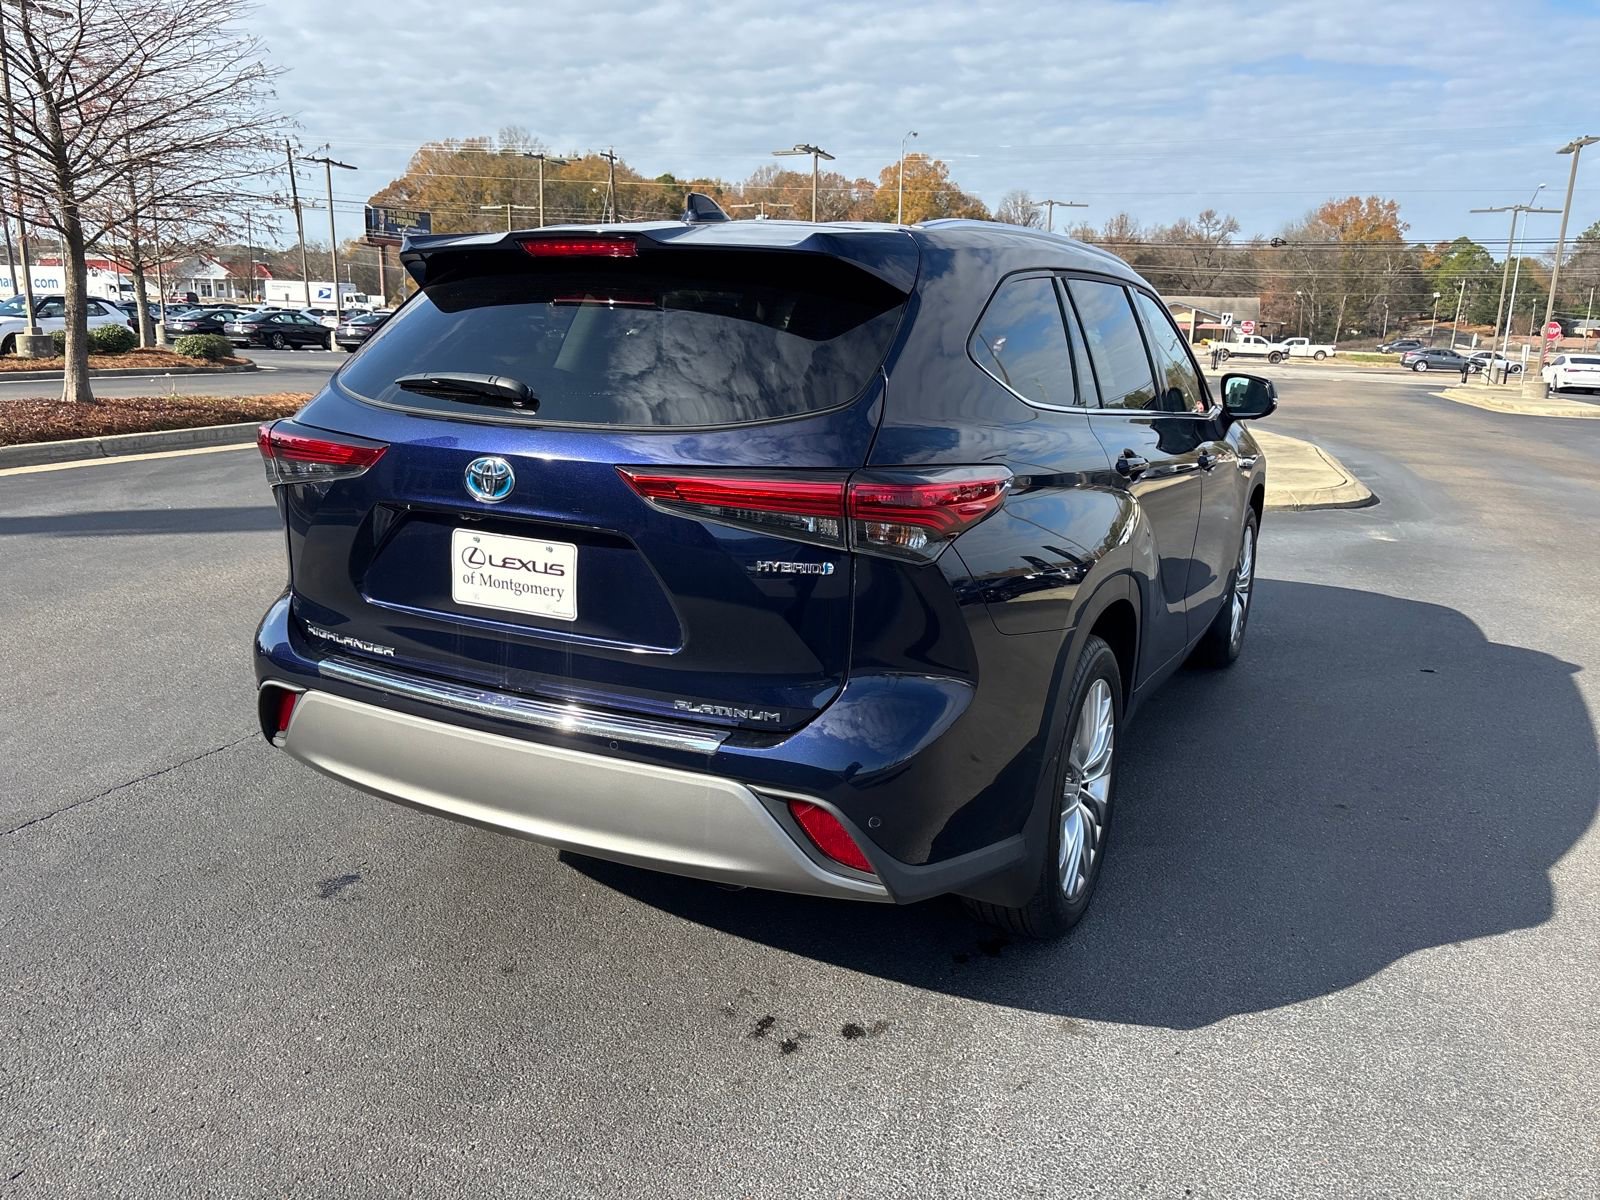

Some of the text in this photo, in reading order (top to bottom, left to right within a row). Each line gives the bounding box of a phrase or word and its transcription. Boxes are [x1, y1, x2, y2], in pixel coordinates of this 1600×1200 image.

[488, 554, 565, 577] LEXUS
[756, 560, 822, 574] HYBRID
[462, 571, 565, 602] of Montgomery
[306, 622, 396, 657] HIGHLANDER
[673, 699, 781, 723] PLATINUM
